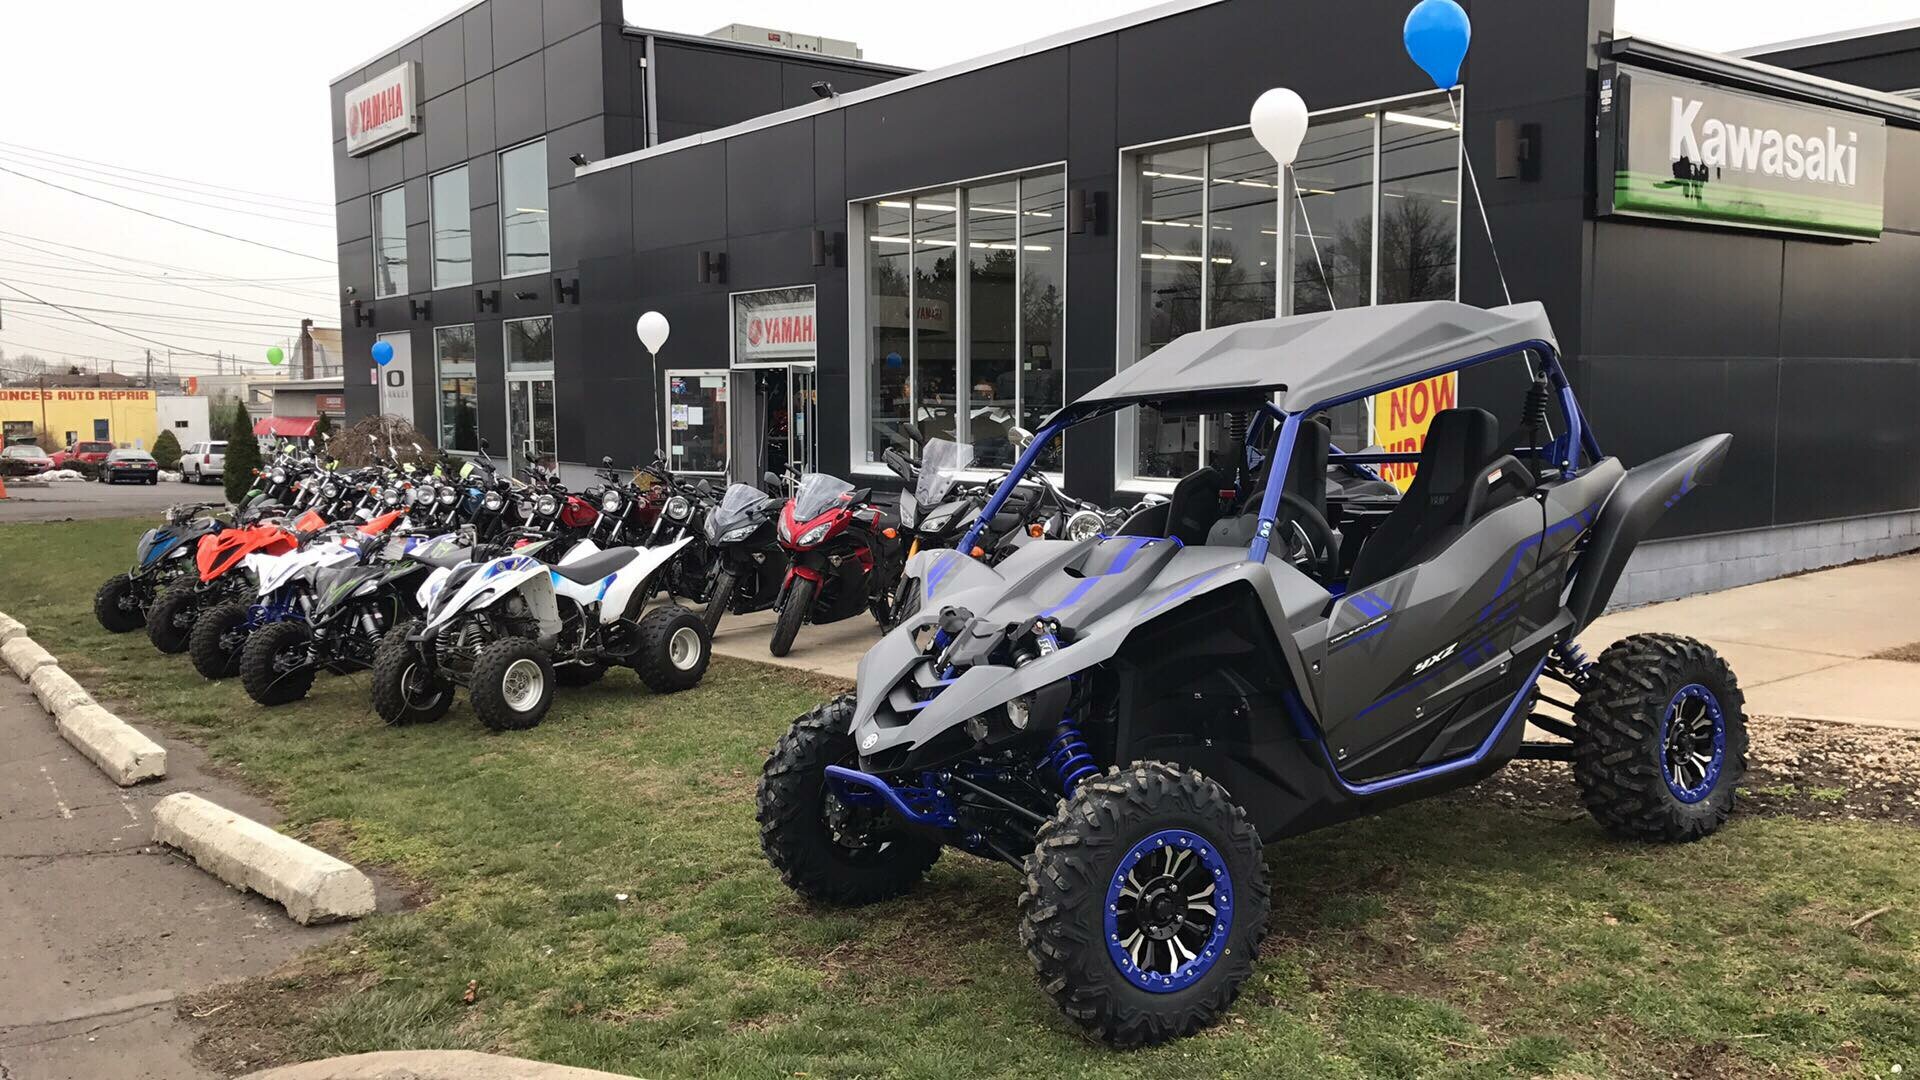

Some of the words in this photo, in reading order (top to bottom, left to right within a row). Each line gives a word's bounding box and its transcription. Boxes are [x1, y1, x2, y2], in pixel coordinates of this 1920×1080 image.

[359, 83, 403, 132] YAMAHA
[1670, 96, 1857, 186] Kawasaki
[764, 315, 816, 344] YAMAH
[58, 391, 95, 400] AUTO
[98, 391, 149, 400] REPAIR
[1389, 375, 1455, 432] NOW
